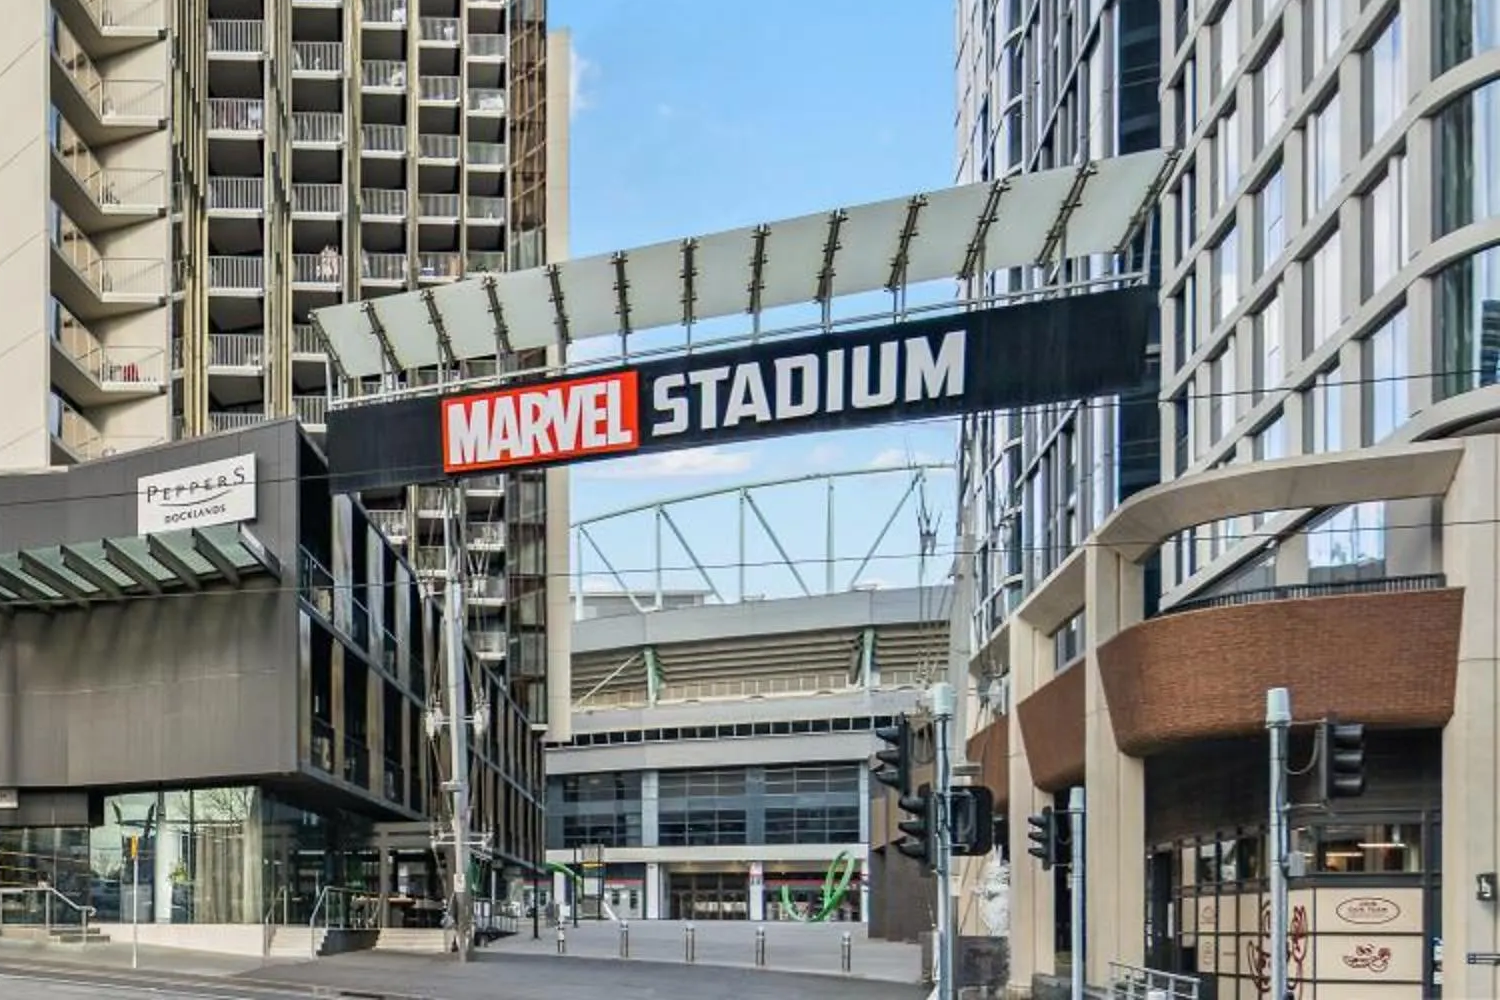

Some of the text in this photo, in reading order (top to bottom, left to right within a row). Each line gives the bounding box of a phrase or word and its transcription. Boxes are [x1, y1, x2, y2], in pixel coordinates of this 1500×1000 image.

[449, 329, 967, 466] MARVEL STADIUM
[147, 465, 245, 503] PEPPERS
[164, 504, 226, 524] DOCKLANDS
